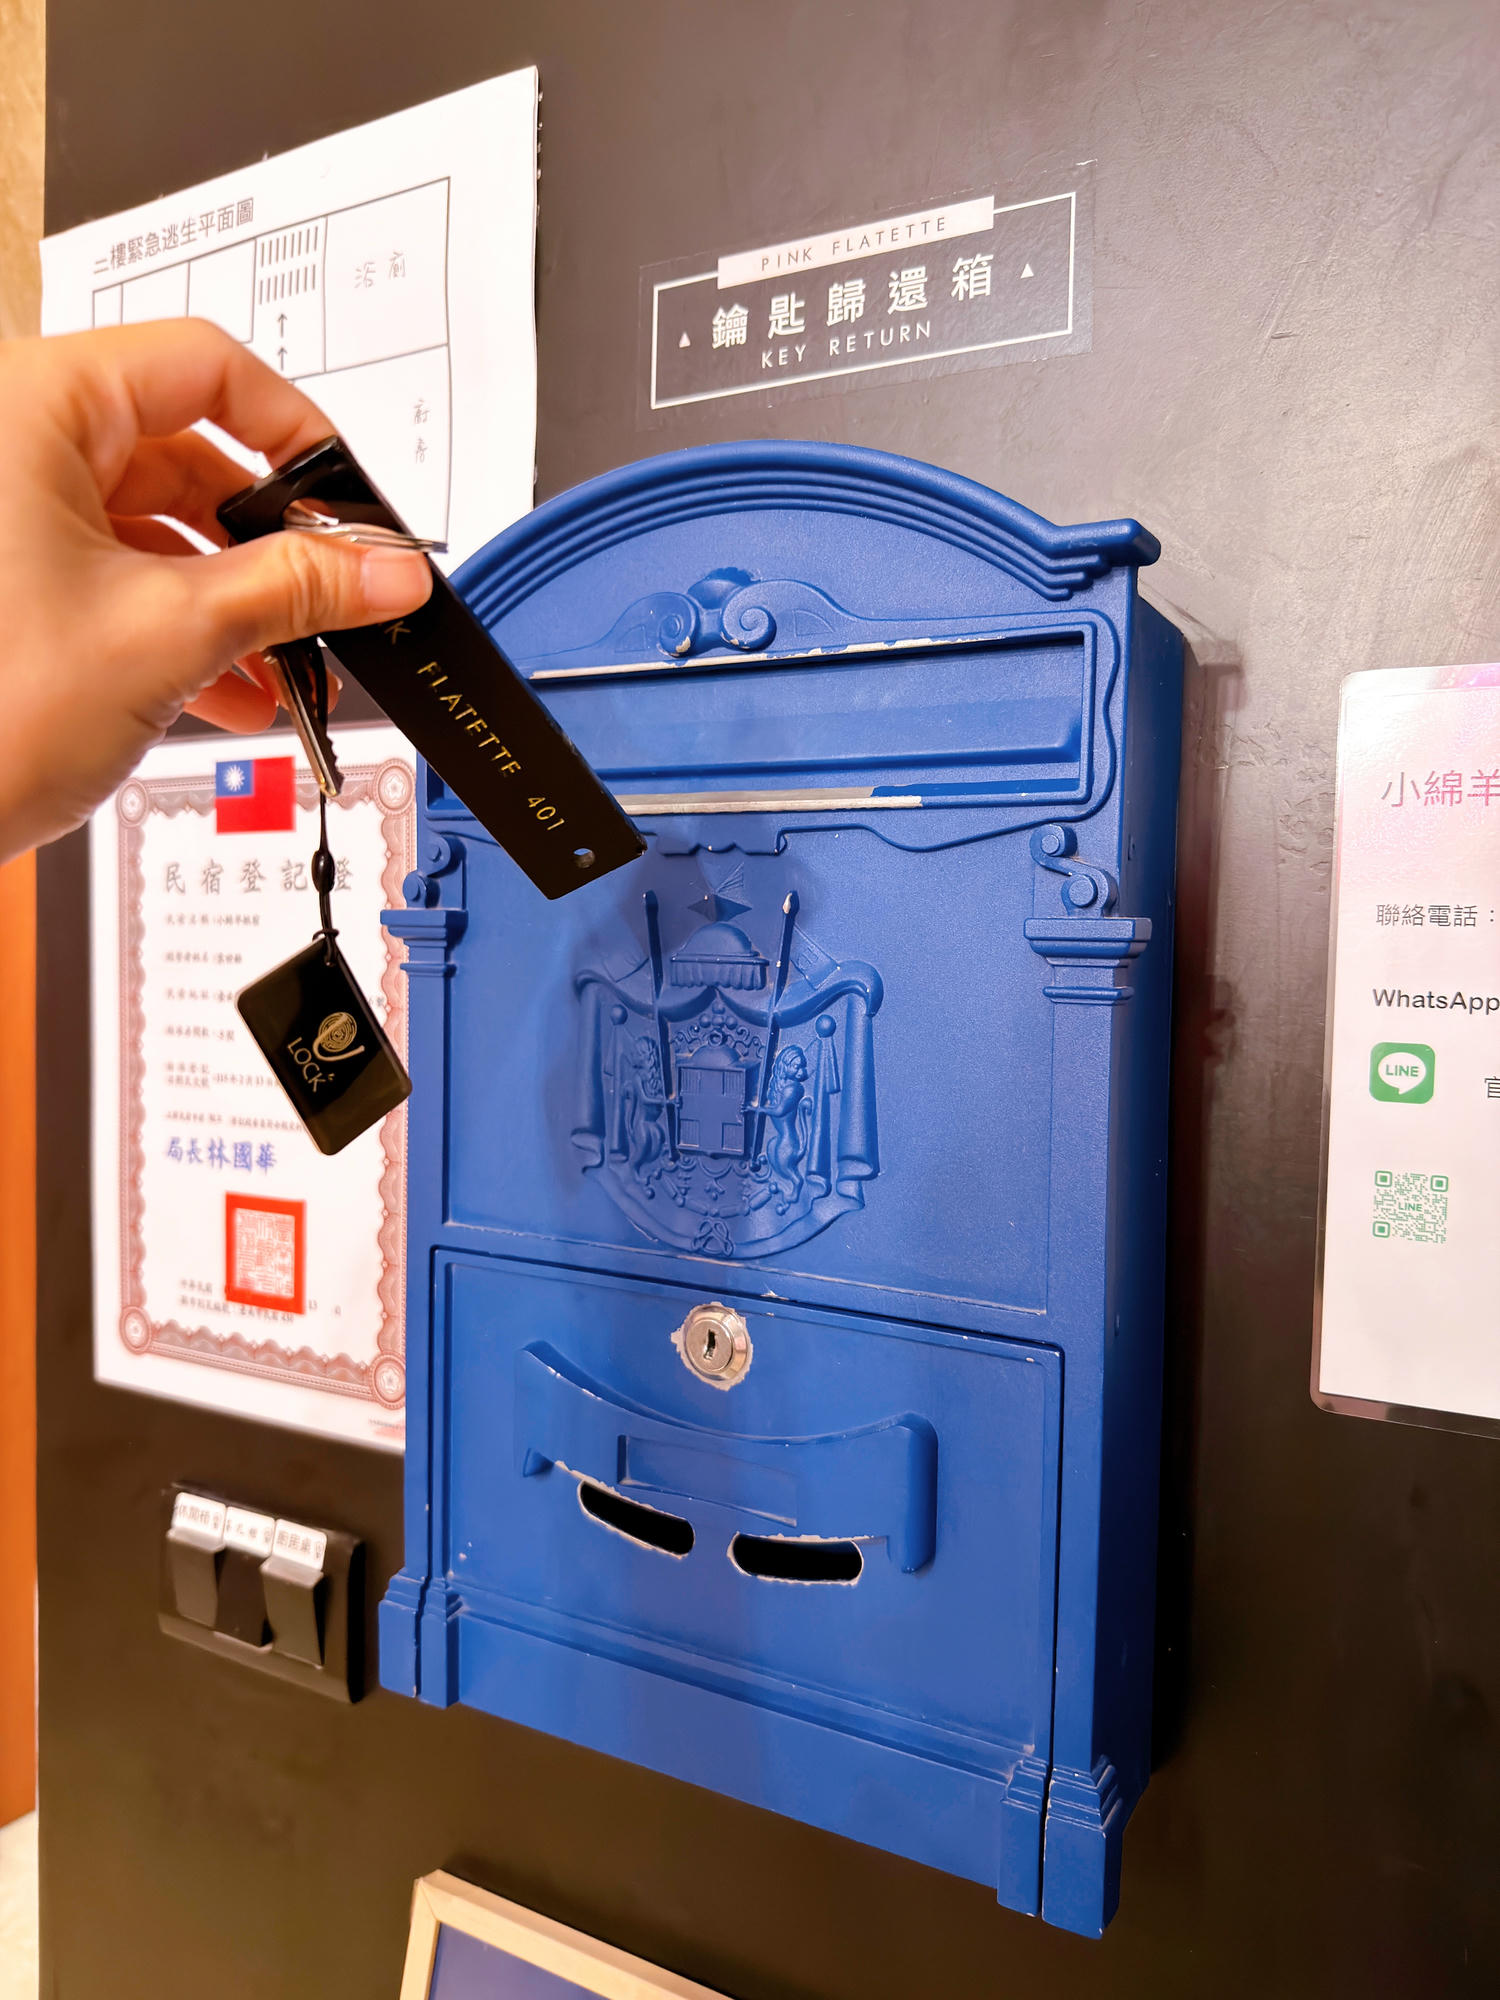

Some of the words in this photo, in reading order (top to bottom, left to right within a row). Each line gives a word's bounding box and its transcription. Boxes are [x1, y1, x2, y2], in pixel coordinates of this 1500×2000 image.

[93, 197, 254, 275] 二樓緊急逃生平面圖
[761, 247, 813, 272] PINK
[832, 216, 947, 256] FLATETTE
[711, 253, 994, 350] 鑰匙歸還箱
[761, 344, 807, 369] KEY
[829, 321, 932, 356] RETURN
[416, 661, 522, 778] FLATETTE
[527, 796, 565, 831] 401
[1381, 768, 1500, 808] 小綿羊
[1372, 988, 1500, 1015] WhatsApp
[1385, 1064, 1420, 1077] LINE
[1398, 1202, 1423, 1212] LINE
